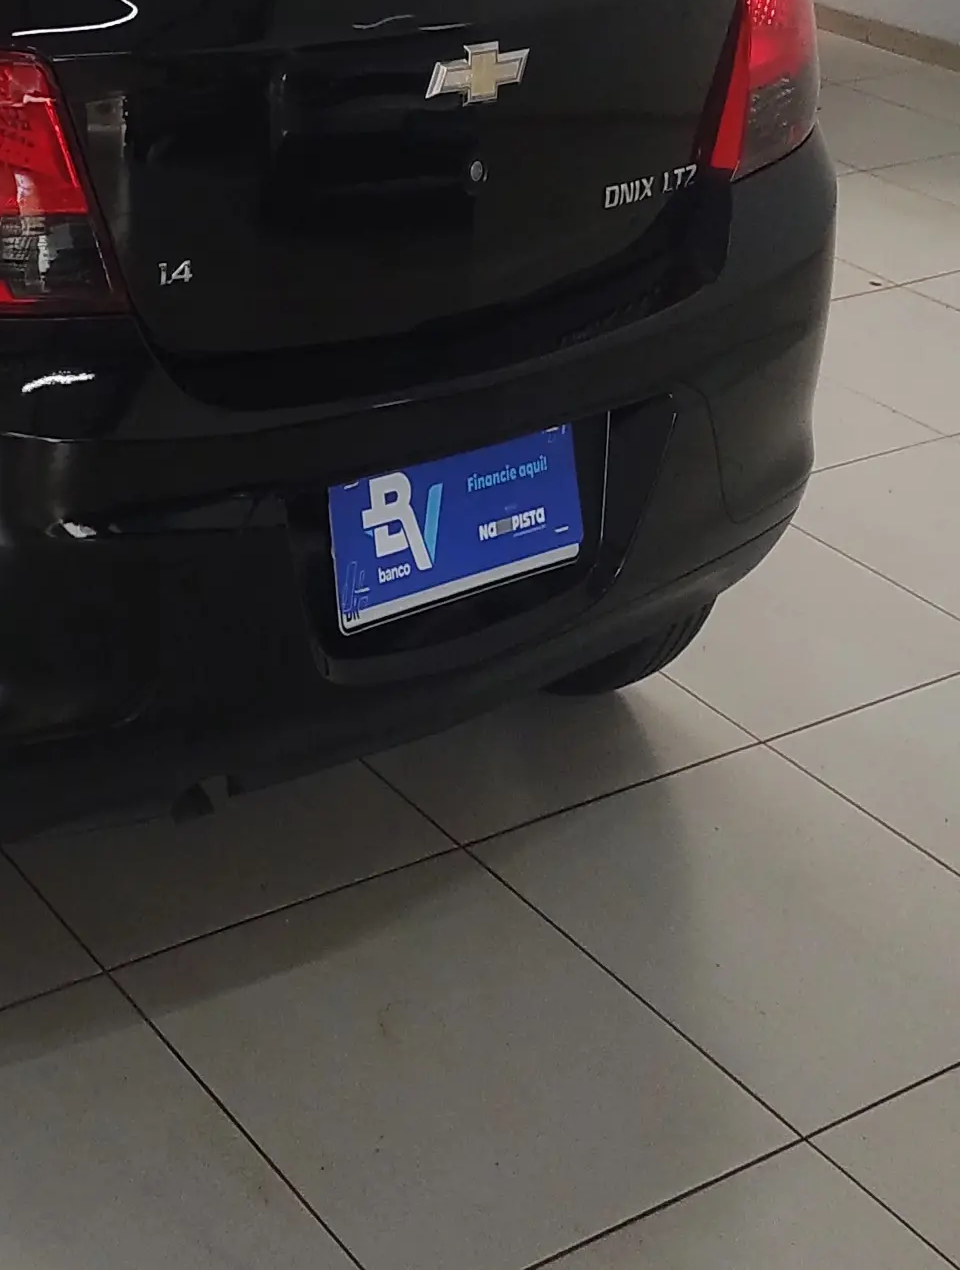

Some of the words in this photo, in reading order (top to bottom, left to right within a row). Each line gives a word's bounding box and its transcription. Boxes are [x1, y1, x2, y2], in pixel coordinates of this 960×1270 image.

[604, 176, 655, 209] ONIX
[662, 163, 698, 194] LTZ
[467, 464, 517, 493] Financie
[518, 454, 548, 479] aqui!
[377, 563, 411, 584] banco
